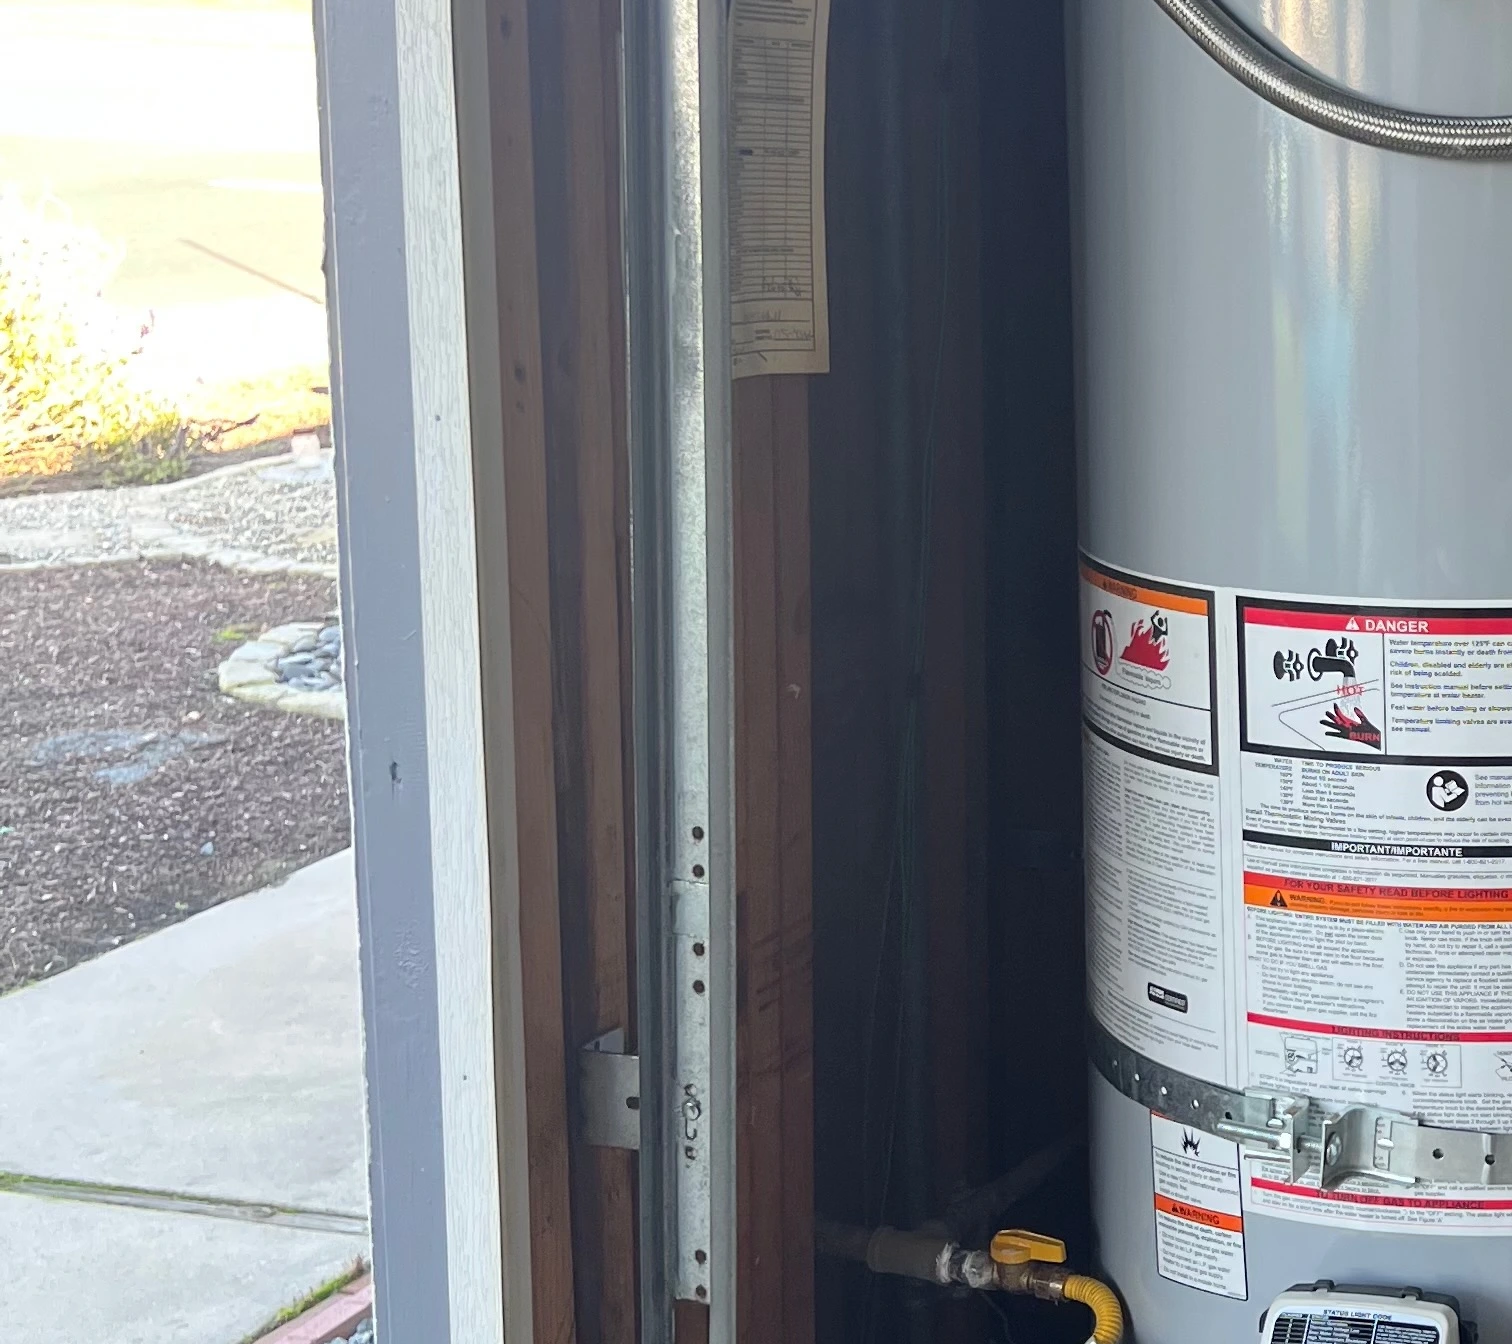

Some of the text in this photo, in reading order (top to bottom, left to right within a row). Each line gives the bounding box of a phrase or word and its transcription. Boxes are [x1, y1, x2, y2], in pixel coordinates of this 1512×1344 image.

[1365, 619, 1429, 633] DANGER
[1411, 640, 1452, 648] temperature
[1349, 731, 1380, 741] BURN
[1331, 842, 1463, 857] IMPORTANT/IMPORTANTE
[1283, 879, 1509, 899] FOR YOUR SAFETY READ BEFORE LIGHTING
[1408, 1198, 1422, 1207] TO
[1423, 1200, 1484, 1209] APPLIANCE
[1179, 1206, 1219, 1224] WARNING
